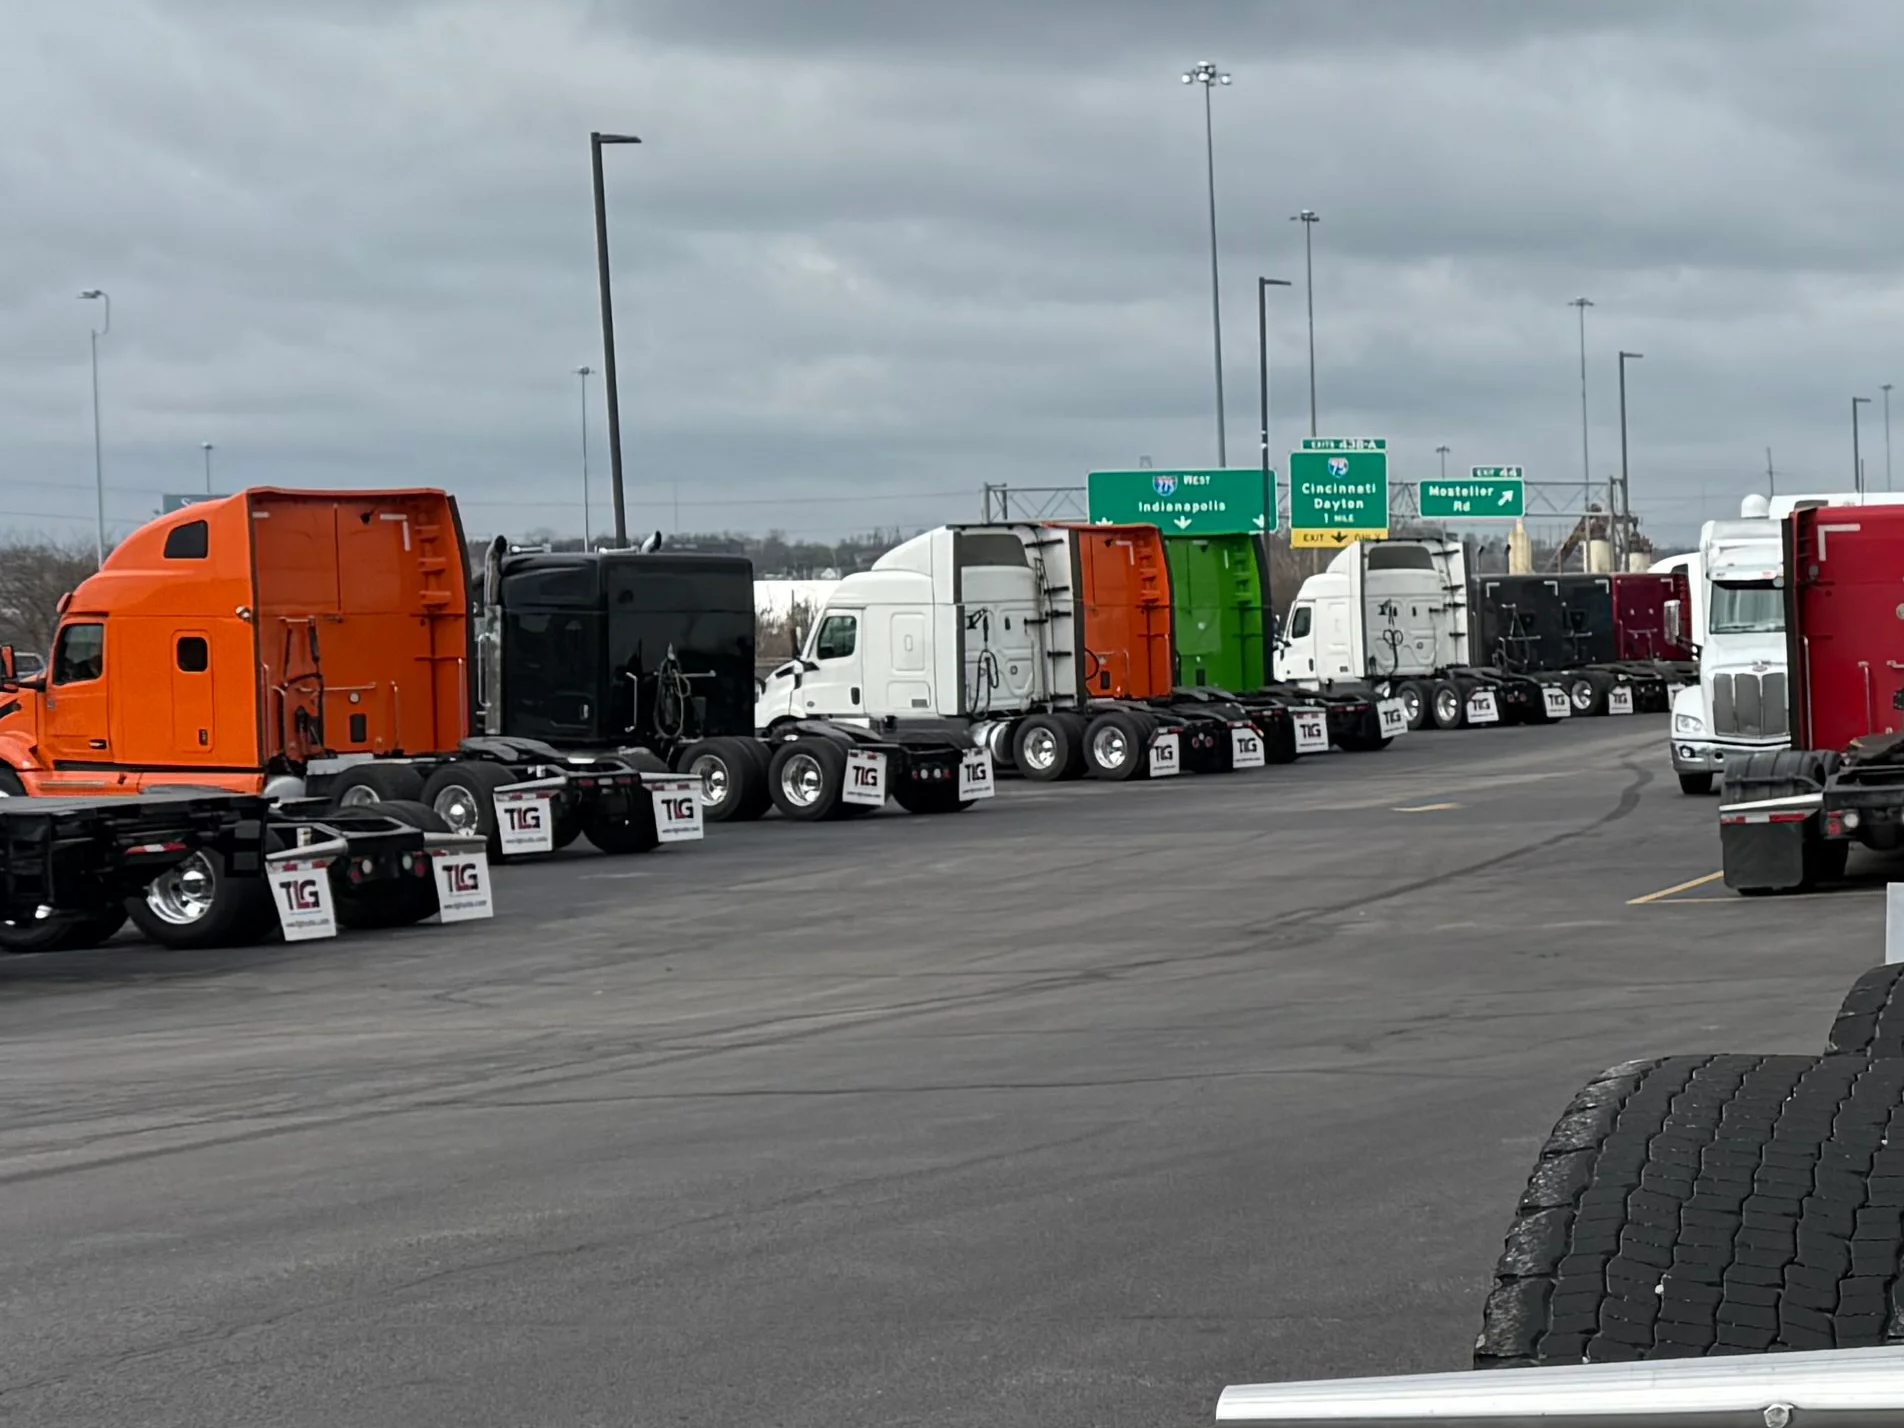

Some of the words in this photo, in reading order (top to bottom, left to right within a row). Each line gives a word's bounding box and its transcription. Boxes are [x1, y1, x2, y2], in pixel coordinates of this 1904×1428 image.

[1183, 475, 1211, 486] WEST
[1302, 483, 1376, 495] Cincinnati
[1139, 501, 1226, 514] Indianapolis
[1314, 499, 1364, 511] Dayton
[1453, 501, 1471, 512] Rd
[1324, 514, 1329, 524] 1
[1334, 514, 1354, 522] MILE
[1303, 534, 1324, 542] EXIT
[661, 798, 694, 821] TLG
[504, 807, 541, 830] TLG
[442, 863, 479, 892] TLG
[279, 880, 320, 910] TLG
